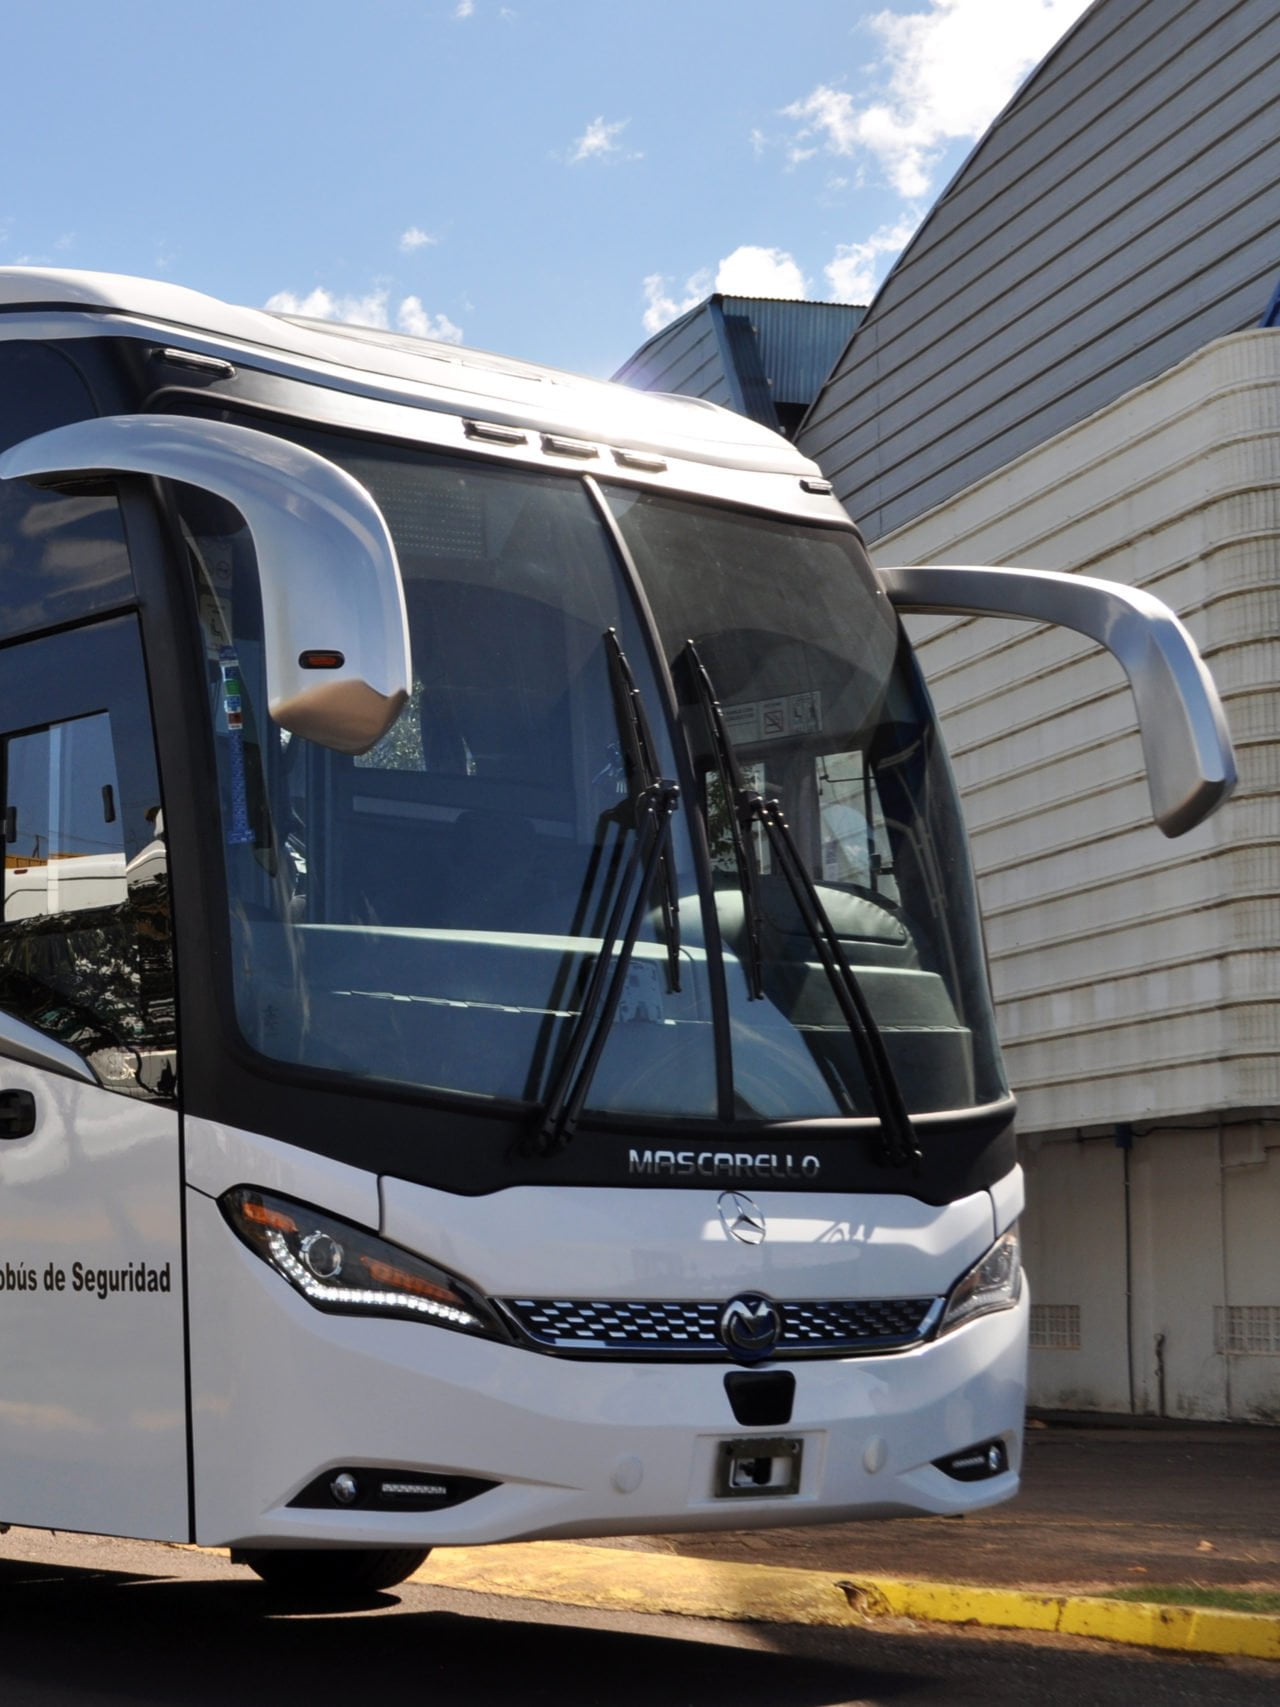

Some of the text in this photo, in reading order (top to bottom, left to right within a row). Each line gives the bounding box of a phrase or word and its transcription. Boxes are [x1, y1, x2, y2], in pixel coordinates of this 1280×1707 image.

[628, 1149, 820, 1178] MASCARELLO
[43, 1262, 66, 1291] de
[71, 1262, 171, 1300] Seguridad
